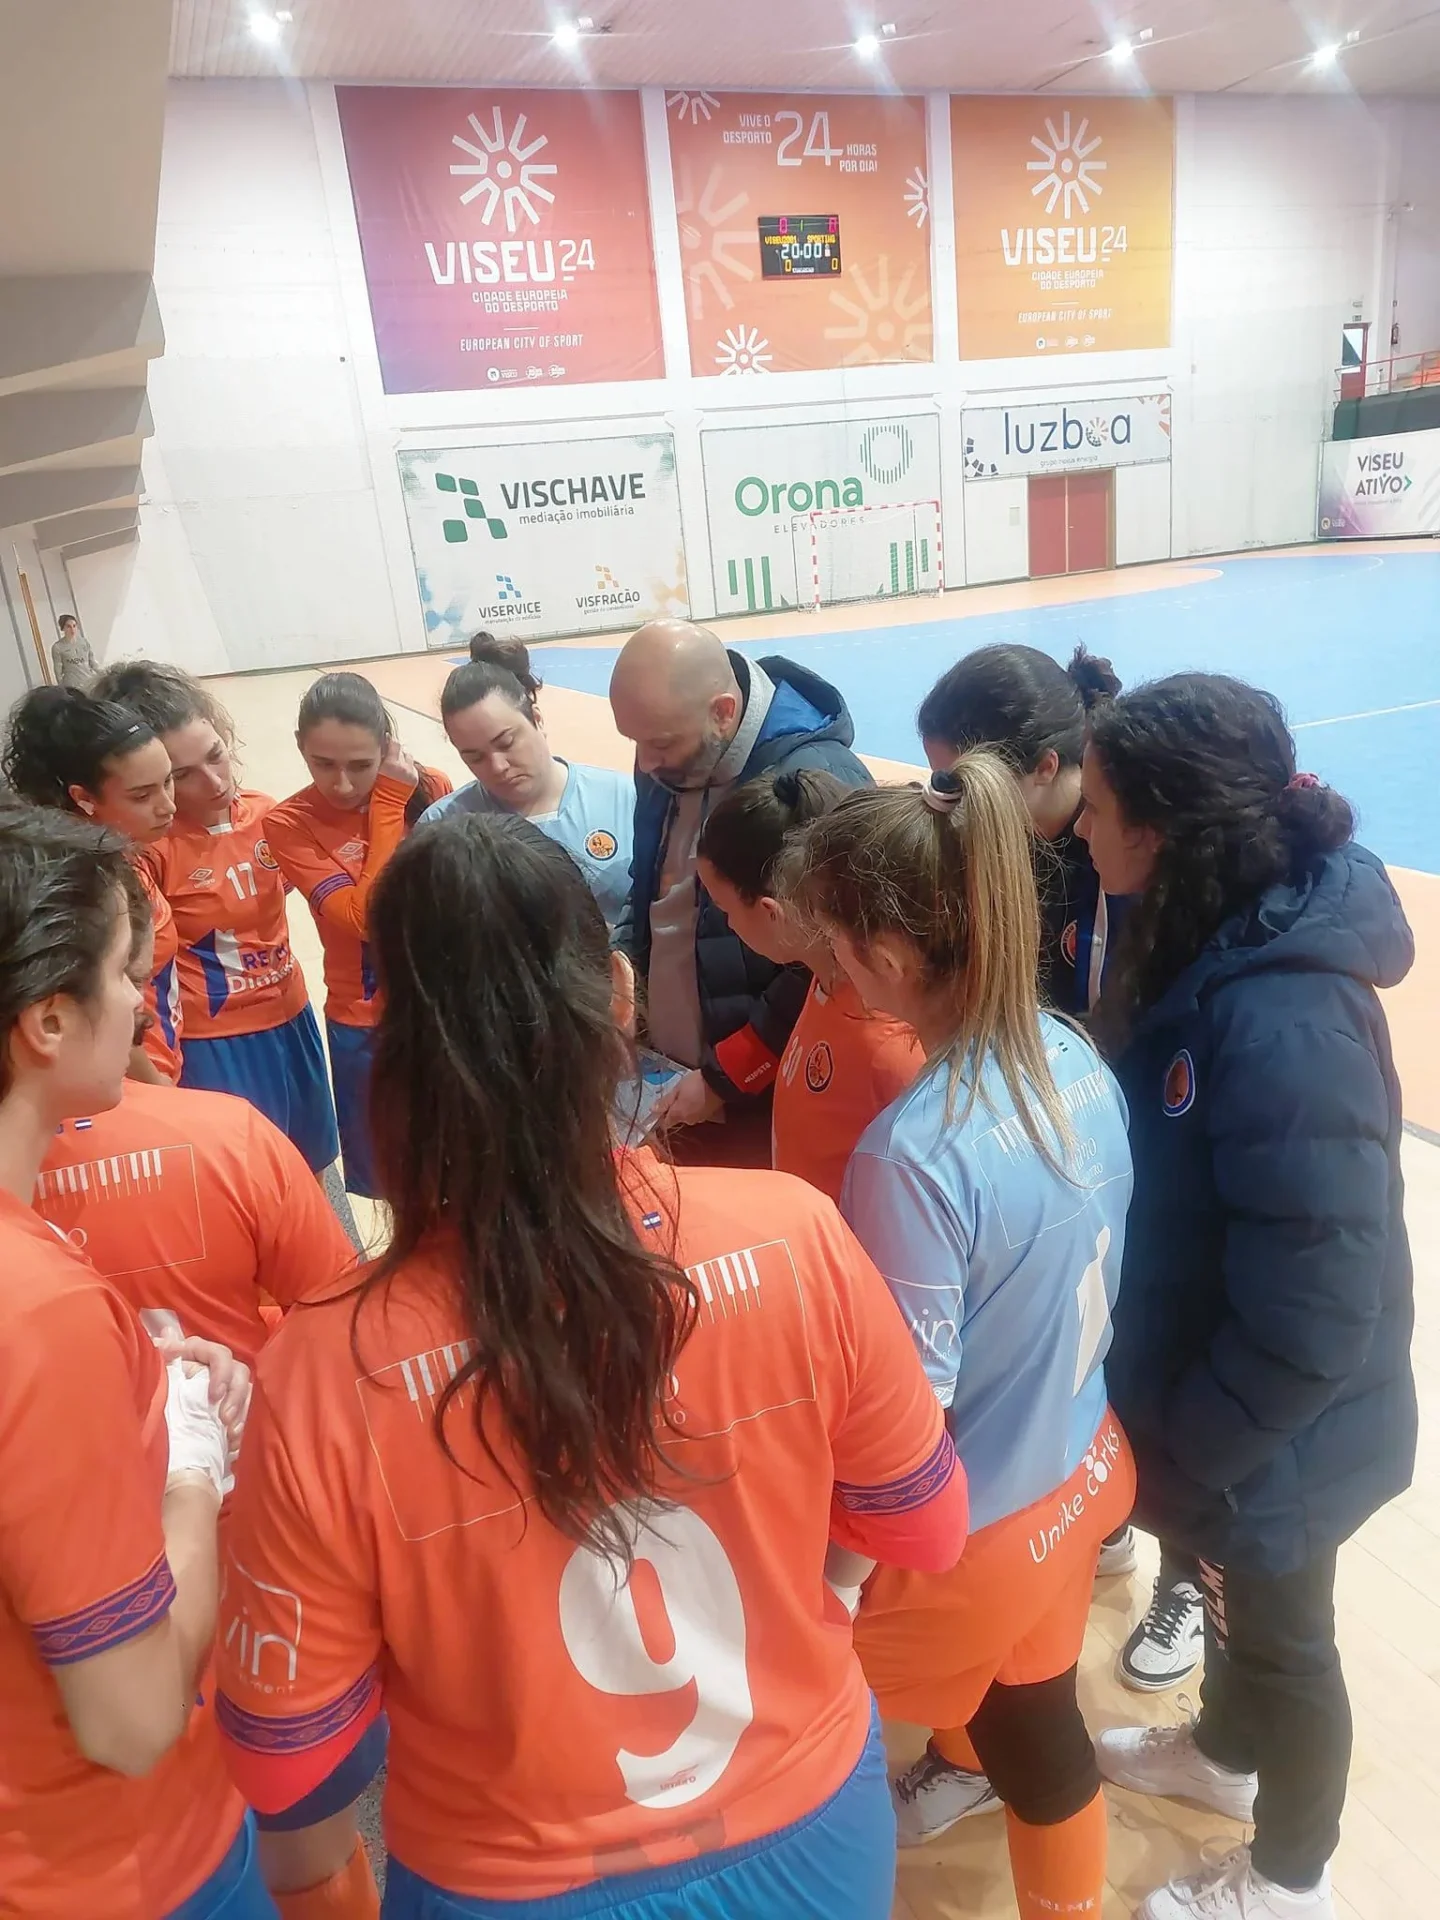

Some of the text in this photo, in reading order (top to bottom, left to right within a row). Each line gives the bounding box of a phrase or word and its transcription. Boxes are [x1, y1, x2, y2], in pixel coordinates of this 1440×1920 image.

[739, 114, 771, 127] VIVE O
[723, 131, 772, 144] DESPORTO
[775, 110, 844, 166] 24
[847, 144, 877, 156] HORAS
[840, 160, 878, 172] POR DIA!
[1001, 225, 1128, 266] VISEU 24
[424, 239, 596, 285] VISEU 24
[1031, 269, 1104, 281] CIDADE EUROPEIA
[1053, 279, 1096, 289] DESPORTO
[472, 289, 568, 302] CIDADE EUROPEIA
[485, 300, 558, 313] DO DESPORTO
[1018, 308, 1112, 323] EUROPEAN CITY OF SPORT
[460, 333, 583, 351] EUROPEAN CITY OF SPORT
[1357, 452, 1403, 472] VISEU
[500, 472, 646, 509] VISCHAVE
[1355, 475, 1403, 496] ATIVO
[735, 476, 863, 516] Orona
[519, 504, 635, 525] mediação imobiliária
[478, 601, 542, 618] VISERVICE
[225, 862, 258, 900] 17
[1029, 1493, 1085, 1564] Unike
[559, 1499, 754, 1810] 9
